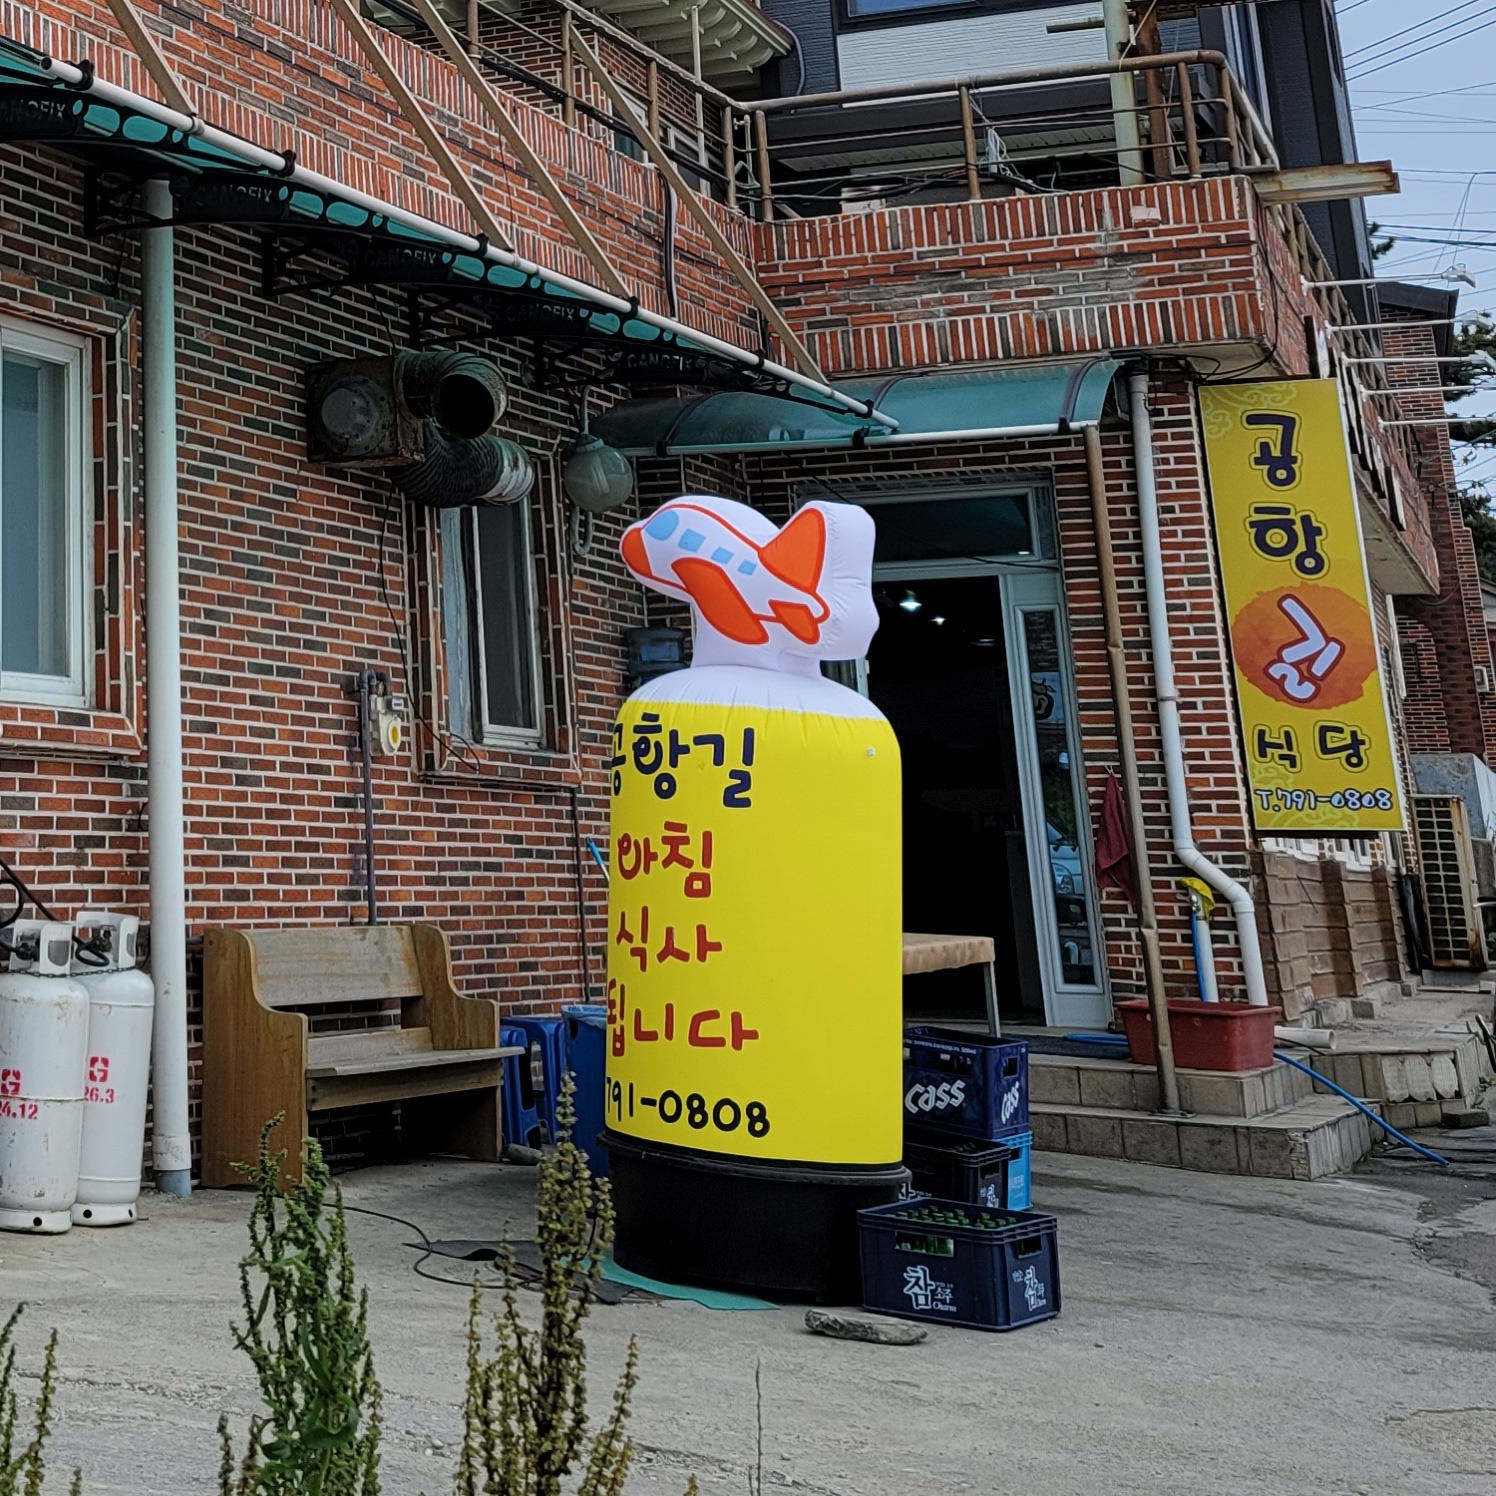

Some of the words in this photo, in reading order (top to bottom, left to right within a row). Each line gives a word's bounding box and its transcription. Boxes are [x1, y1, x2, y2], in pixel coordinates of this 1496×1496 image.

[1253, 786, 1393, 812] T.791-0808
[617, 820, 713, 899] 아침
[615, 905, 723, 973] 식사
[903, 1264, 936, 1310] 참
